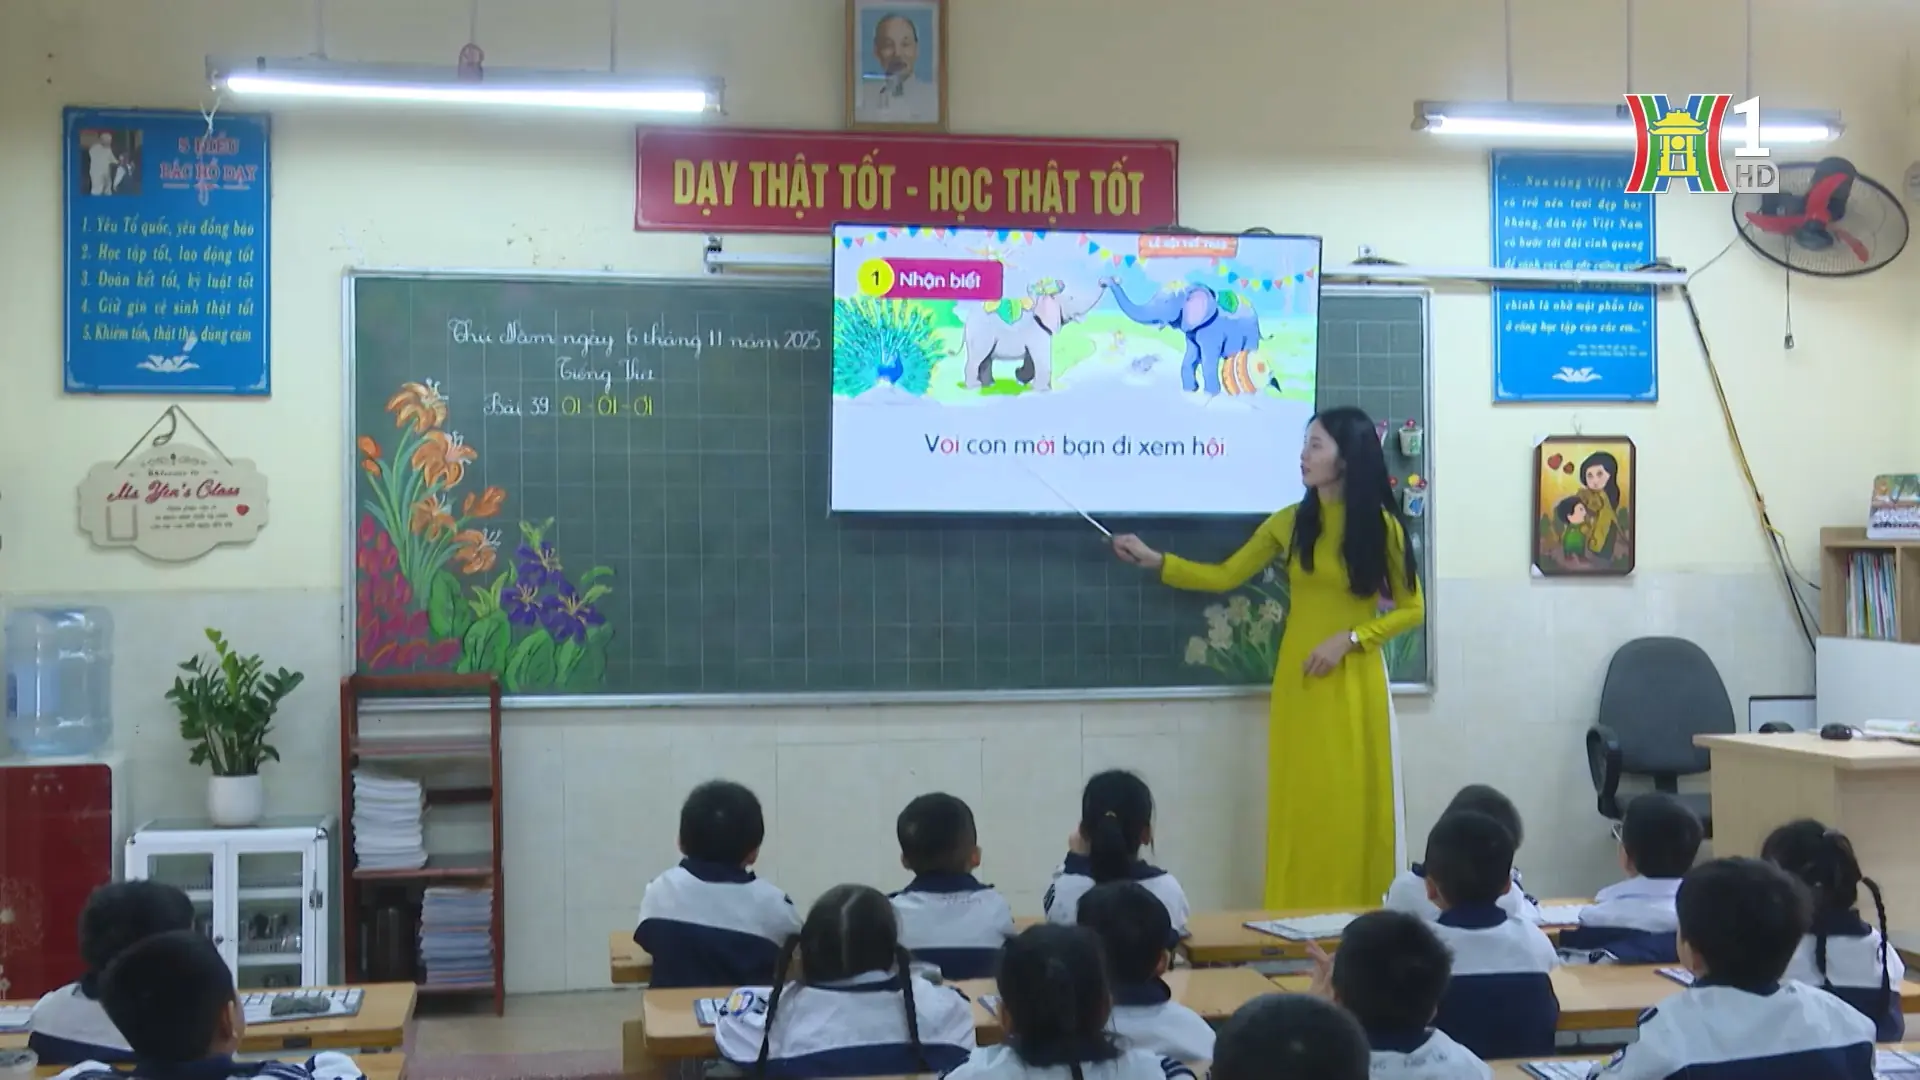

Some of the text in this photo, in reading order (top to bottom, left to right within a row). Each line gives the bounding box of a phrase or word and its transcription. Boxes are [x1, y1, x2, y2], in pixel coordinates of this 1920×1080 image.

[674, 159, 739, 216] DẠY
[749, 152, 829, 219] THẬT
[838, 148, 896, 210] TỐT
[929, 166, 993, 223] HỌC
[1003, 160, 1081, 224] THẬT
[1089, 155, 1145, 216] TỐT
[97, 216, 118, 233] Yêu
[1593, 217, 1615, 232] Việt
[1619, 218, 1643, 230] Nam
[98, 243, 120, 265] Học
[871, 269, 982, 290] 1 Nhận biết
[173, 299, 199, 315] sinh
[563, 328, 615, 357] ngày
[626, 327, 638, 345] 6
[643, 322, 702, 359] tháng
[709, 329, 722, 347] 11
[730, 331, 779, 350] năm
[784, 329, 821, 351] 2025
[483, 391, 522, 416] Bài
[530, 396, 549, 417] 39
[924, 433, 960, 454] Voi
[967, 438, 1007, 455] con
[1014, 434, 1056, 456] mời
[1063, 433, 1105, 460] bạn
[1112, 433, 1132, 456] đi
[1138, 440, 1185, 456] xem
[107, 482, 141, 502] Ms
[196, 478, 241, 499] Class
